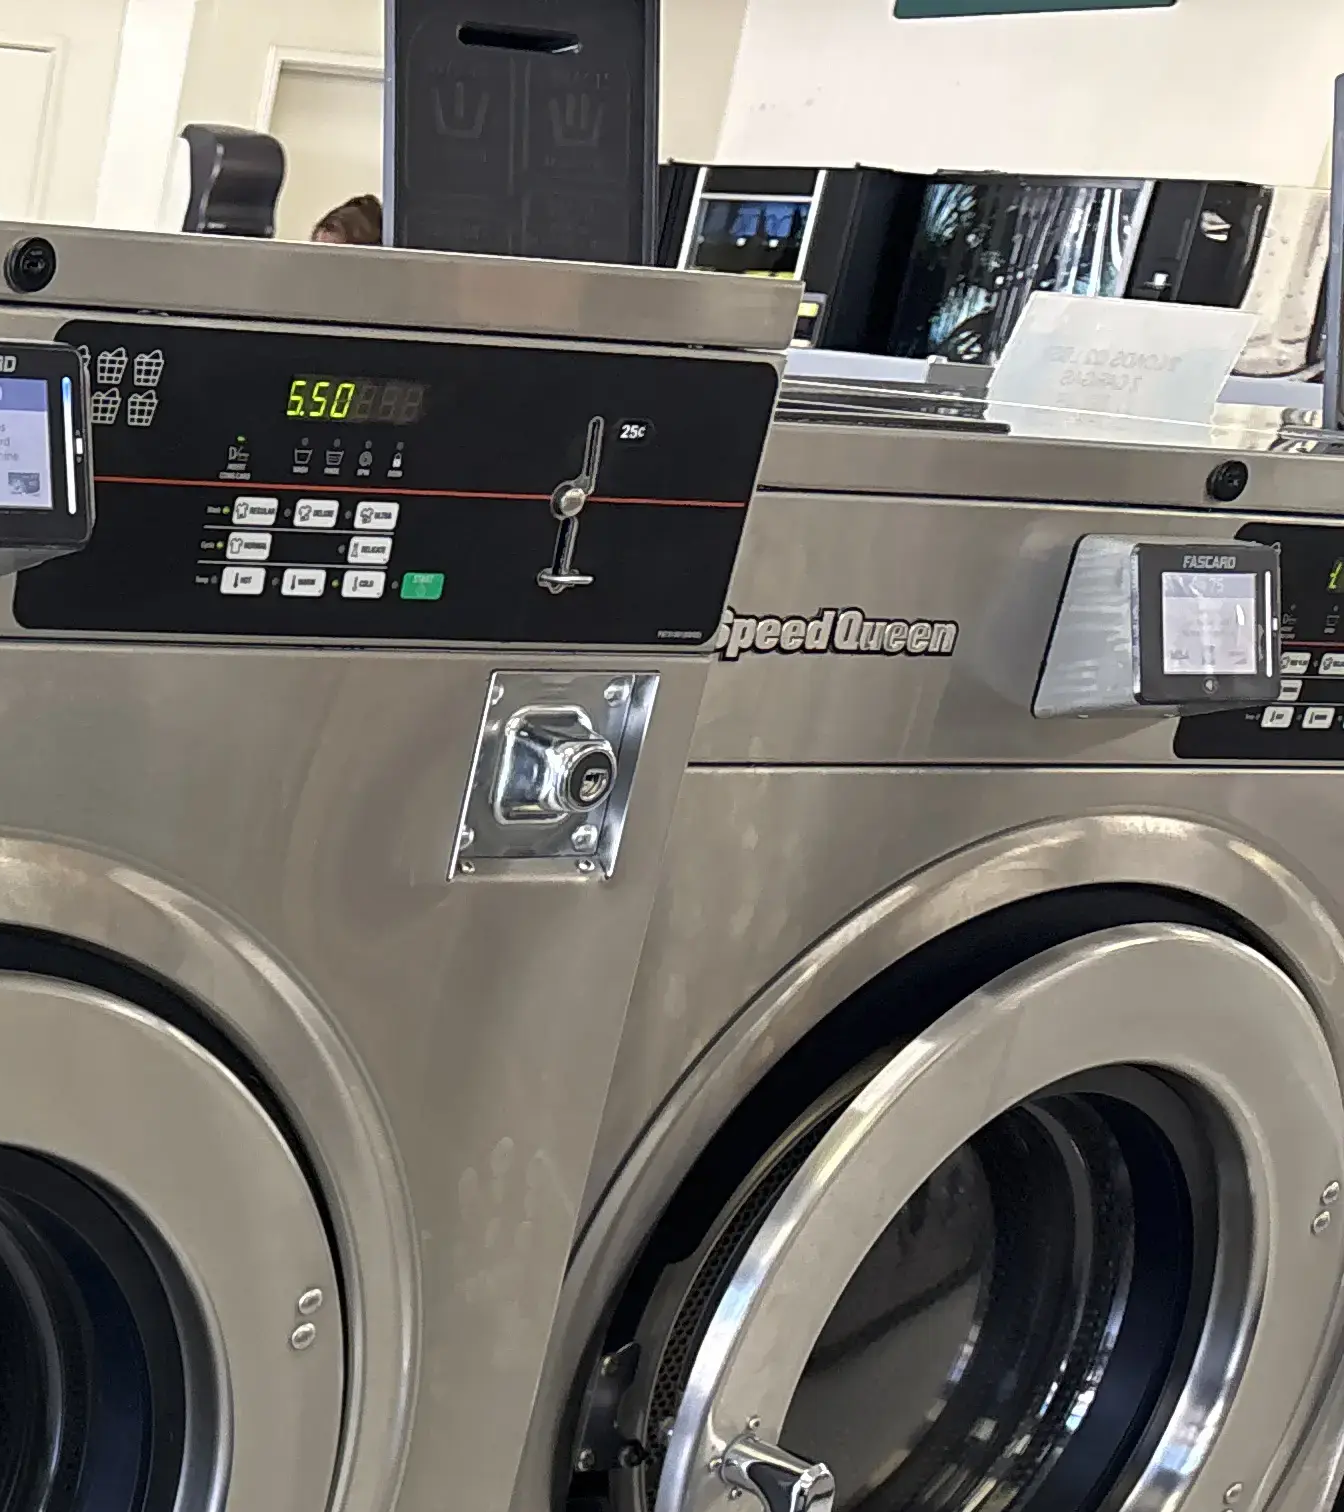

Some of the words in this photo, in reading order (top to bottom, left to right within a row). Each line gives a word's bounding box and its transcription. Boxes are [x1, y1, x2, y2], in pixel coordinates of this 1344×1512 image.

[620, 424, 646, 439] 25¢
[1182, 555, 1236, 569] FASCARD
[715, 606, 838, 661] Speed
[833, 607, 959, 657] Queen
